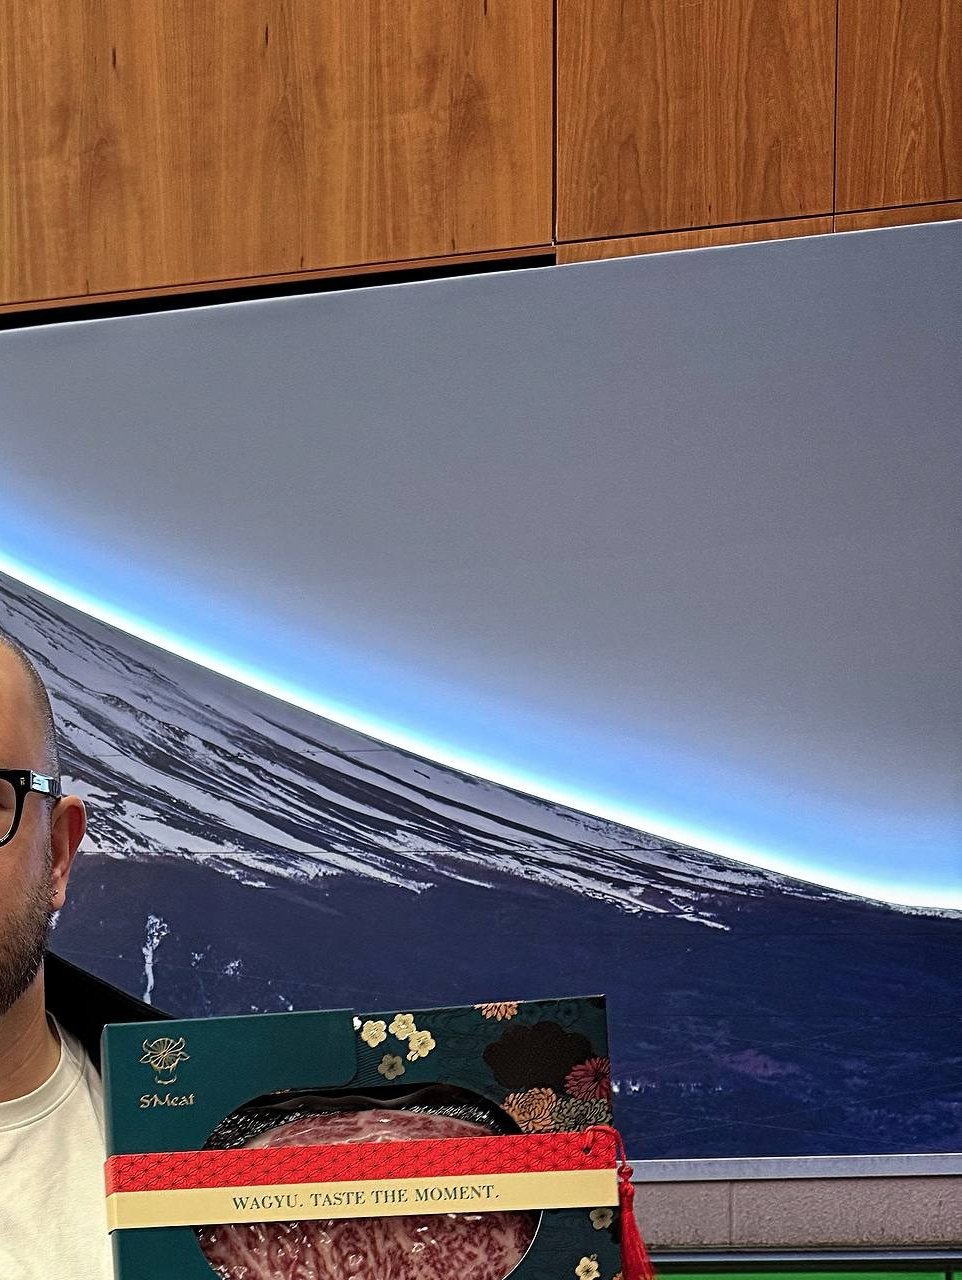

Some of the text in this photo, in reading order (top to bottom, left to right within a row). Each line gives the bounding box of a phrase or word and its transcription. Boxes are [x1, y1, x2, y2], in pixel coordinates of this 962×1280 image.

[232, 1184, 500, 1210] WAGYU. TASTE THE MOMENT.
